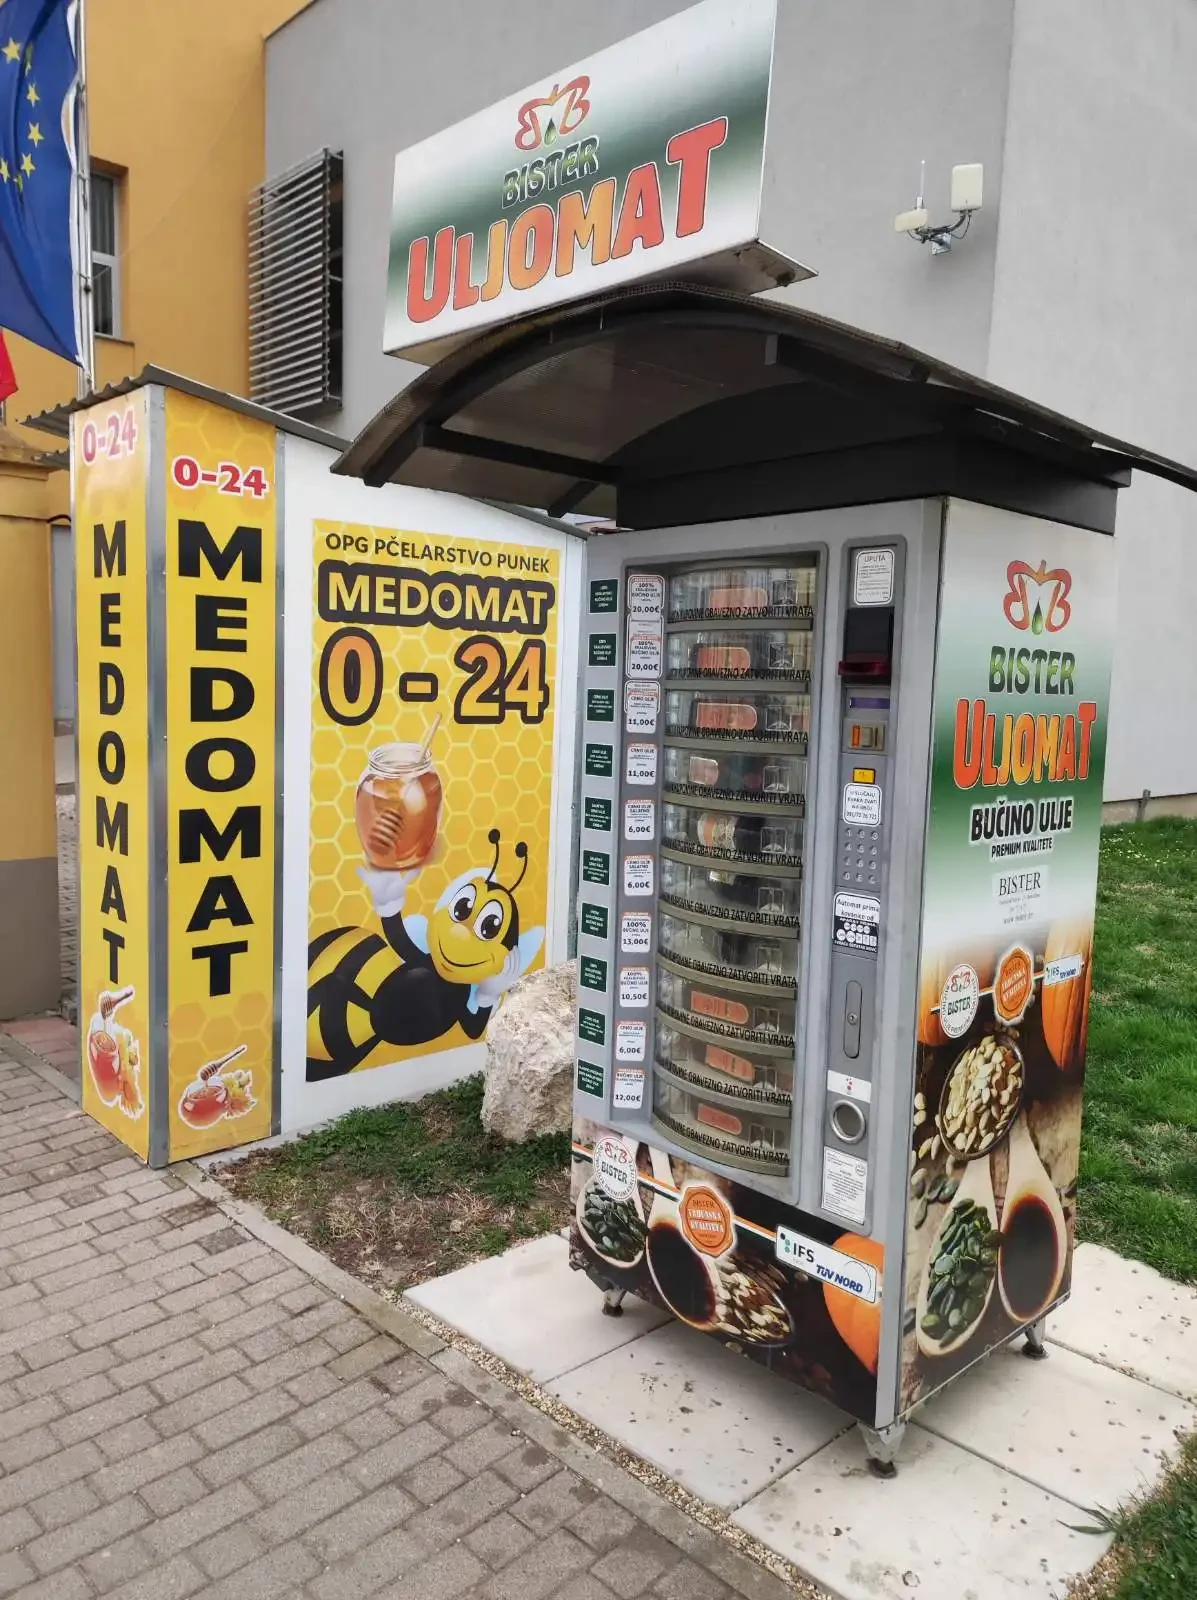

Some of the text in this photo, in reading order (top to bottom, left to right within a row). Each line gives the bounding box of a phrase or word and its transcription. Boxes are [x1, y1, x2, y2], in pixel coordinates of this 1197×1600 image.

[502, 136, 600, 209] BISTER
[406, 115, 728, 324] ULJOMAT
[83, 408, 137, 463] 0-24
[172, 457, 268, 497] 0-24
[325, 533, 550, 574] OPG PČELARSTVO PUNEK
[325, 568, 550, 628] MEDOMAT
[633, 605, 659, 613] 20,00€
[704, 606, 741, 619] OBAVEZNO
[742, 606, 784, 618] ZATVORITI
[785, 605, 813, 617] VRATA
[631, 663, 658, 671] 20,00€
[703, 667, 739, 679] OBAVEZNO
[740, 668, 783, 680] ZATVORITI
[784, 669, 812, 682] VRATA
[989, 646, 1076, 695] BISTER
[454, 635, 550, 725] 24
[628, 718, 654, 726] 11,00€
[781, 731, 808, 742] VRATA
[953, 698, 1097, 789] ULJOMAT
[94, 520, 128, 985] MEDOMAT
[178, 519, 262, 997] MEDOMAT
[628, 770, 654, 778] 11,00€
[699, 785, 733, 800] OBAVEZNO
[735, 789, 776, 803] ZATVORITI
[778, 793, 805, 805] VRATA
[628, 825, 651, 833] 6,00€
[971, 800, 1073, 841] BUČINO ULJE
[697, 845, 731, 859] OBAVEZNO
[733, 849, 774, 863] ZATVORITI
[775, 854, 802, 867] VRATA
[991, 837, 1053, 858] PREMIUM KVALITETE
[628, 881, 650, 889] 6,00€
[999, 872, 1041, 896] BISTER
[695, 902, 730, 919] OBAVEZNO
[731, 909, 772, 925] ZATVORITI
[773, 914, 800, 929] VRATA
[693, 959, 727, 977] OBAVEZNO
[728, 968, 769, 984] ZATVORITI
[770, 973, 798, 988] VRATA
[1050, 966, 1060, 977] IFS
[621, 993, 647, 1001] 10,50€
[948, 996, 971, 1016] BISTER
[690, 1015, 725, 1034] OBAVEZNO
[726, 1026, 766, 1043] ZATVORITI
[767, 1033, 795, 1048] VRATA
[615, 1094, 641, 1102] 12,00€
[688, 1071, 722, 1091] OBAVEZNO
[723, 1082, 763, 1102] ZATVORITI
[765, 1090, 792, 1106] VRATA
[687, 1127, 721, 1149] OBAVEZNO
[721, 1140, 761, 1159] ZATVORITI
[762, 1150, 789, 1165] VRATA
[601, 1161, 627, 1184] BISTER
[793, 1242, 864, 1293] IFS TÜV NORD
